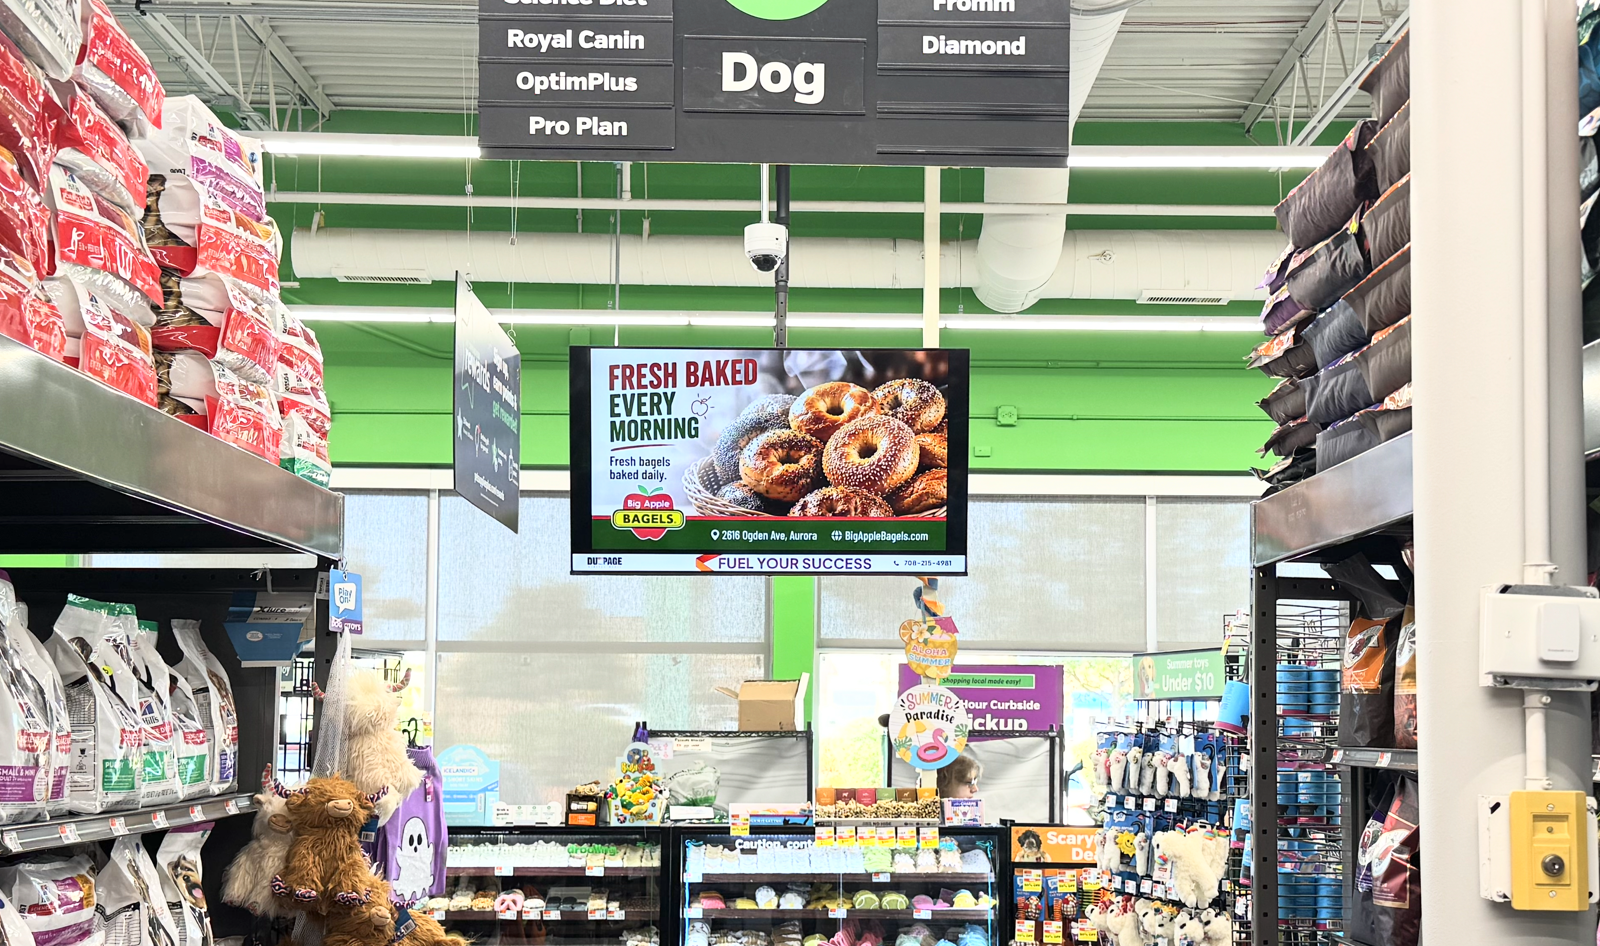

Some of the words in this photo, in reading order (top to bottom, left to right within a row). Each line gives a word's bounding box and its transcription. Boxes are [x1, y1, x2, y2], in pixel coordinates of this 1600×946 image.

[933, 0, 1015, 12] Fromm
[507, 29, 573, 53] Royal
[578, 30, 645, 50] Canin
[922, 35, 1026, 55] Diamond
[516, 71, 638, 95] OptimPlus
[721, 52, 826, 105] Dog
[529, 116, 570, 135] Pro
[576, 117, 628, 136] Plan
[465, 347, 491, 394] rewards
[609, 362, 677, 391] FRESH
[685, 359, 758, 388] BAKED
[609, 392, 676, 418] EVERY
[610, 417, 699, 442] MORNING
[610, 456, 636, 467] Fresh
[639, 457, 671, 469] bagels
[610, 470, 639, 480] baked
[641, 469, 667, 482] daily.
[627, 499, 641, 509] Big
[643, 499, 670, 509] Apple
[722, 531, 740, 540] 2616
[742, 531, 769, 542] Ogden
[770, 531, 788, 541] Ave,
[789, 531, 818, 541] Aurora
[845, 531, 929, 543] BigAppleBagels.com
[718, 557, 754, 569] FUEL
[757, 558, 799, 569] YOUR
[802, 557, 872, 570] SUCCESS
[338, 587, 353, 599] Play
[339, 595, 351, 604] On!
[912, 645, 948, 656] ALOHA
[908, 653, 951, 666] SUMMER
[1166, 659, 1193, 670] Summer
[1193, 658, 1209, 669] toys
[942, 677, 971, 685] Shopping
[1005, 678, 1022, 686] easy!
[1162, 674, 1193, 692] Under
[1194, 672, 1214, 693] $10
[906, 691, 953, 710] SUMMER
[990, 699, 1041, 711] Curbside
[967, 713, 1028, 731] ickup
[735, 839, 784, 850] Caution,
[1047, 831, 1095, 849] Scary
